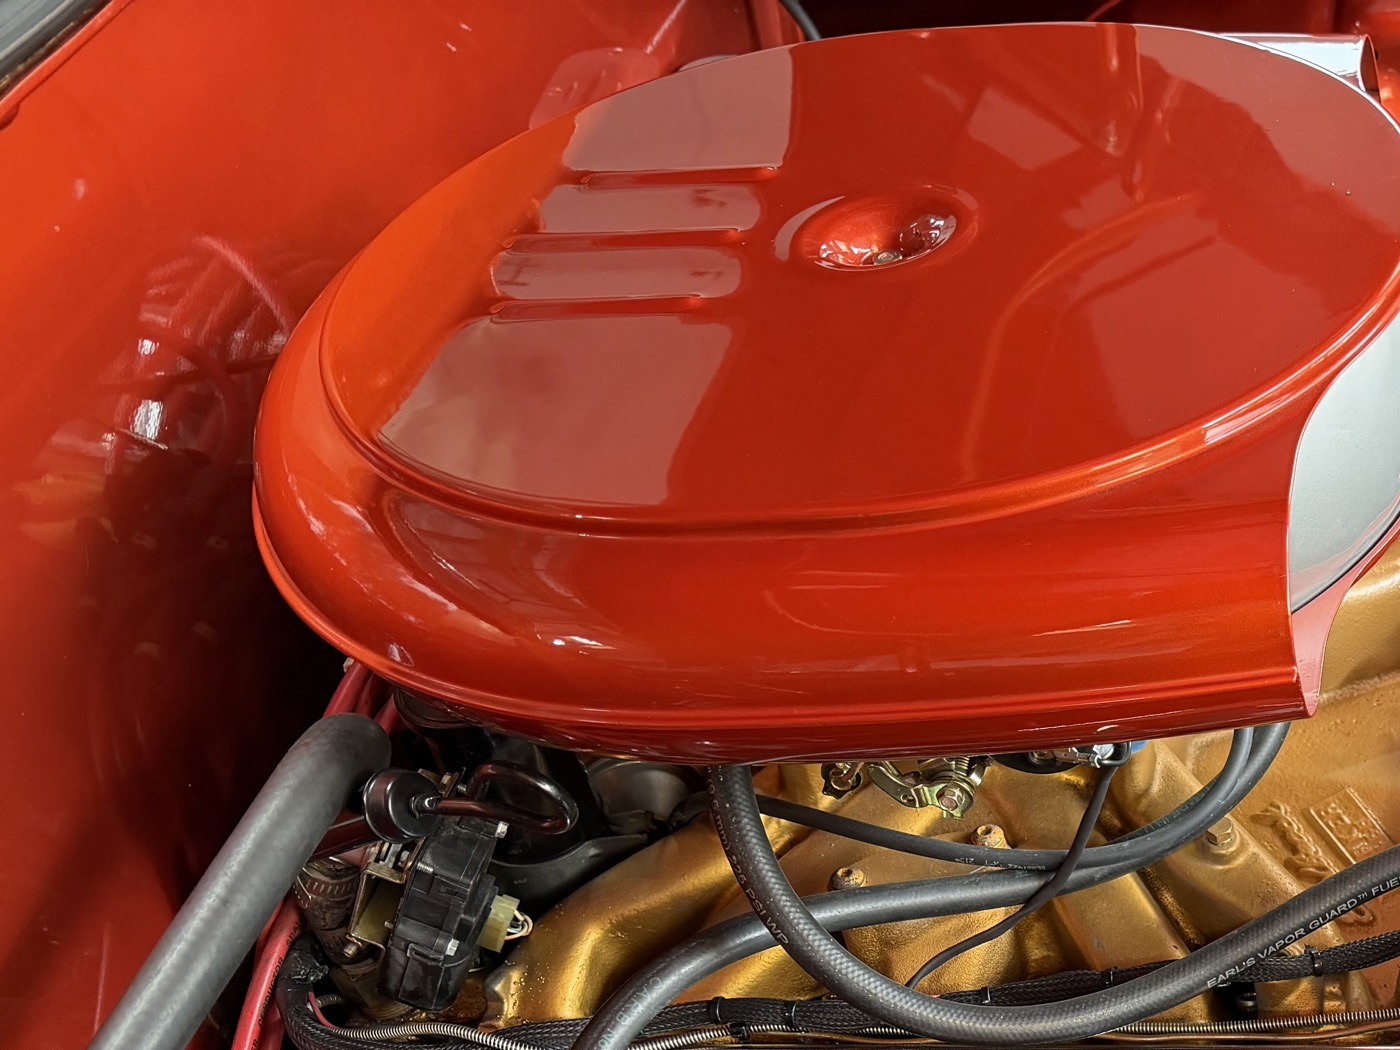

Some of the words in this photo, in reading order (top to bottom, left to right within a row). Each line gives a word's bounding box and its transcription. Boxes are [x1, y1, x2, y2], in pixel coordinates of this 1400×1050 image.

[746, 888, 766, 916] PSI
[766, 917, 790, 945] WP
[1206, 957, 1257, 989] EARL'S
[1257, 928, 1307, 960] VAPOR
